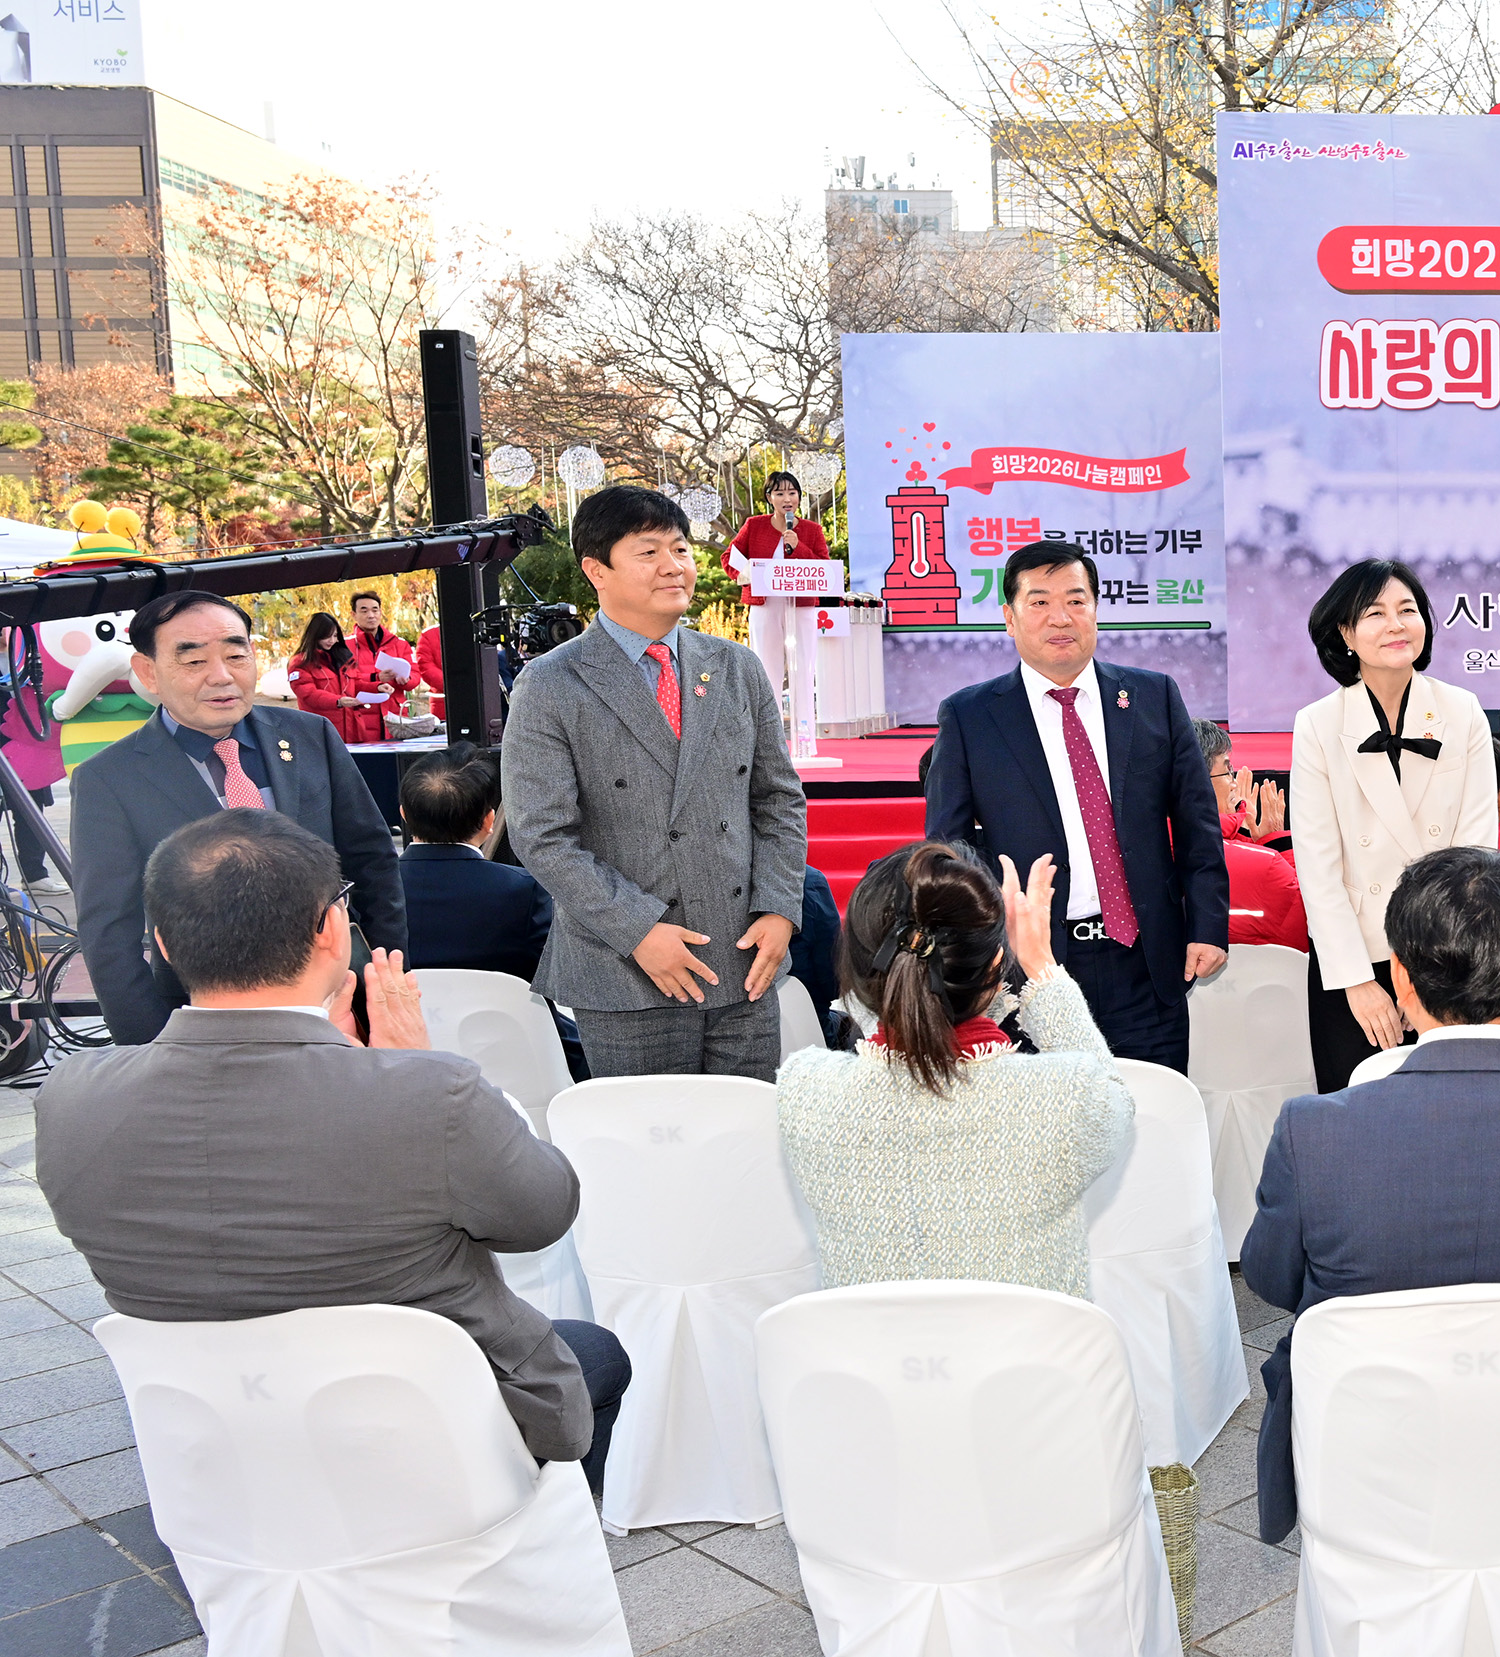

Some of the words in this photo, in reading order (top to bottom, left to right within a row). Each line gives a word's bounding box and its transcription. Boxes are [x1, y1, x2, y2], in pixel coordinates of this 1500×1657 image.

[53, 0, 126, 22] 서비스
[1328, 327, 1492, 401] 사랑의
[990, 454, 1163, 487] 희망2026나눔캠페인
[1154, 529, 1203, 554] 기부
[773, 565, 825, 578] 희망2026
[771, 579, 828, 592] 나눔캠페인
[1096, 580, 1149, 605] 꾸는
[1156, 579, 1205, 605] 울산
[648, 1125, 684, 1145] SK
[901, 1355, 953, 1382] SK
